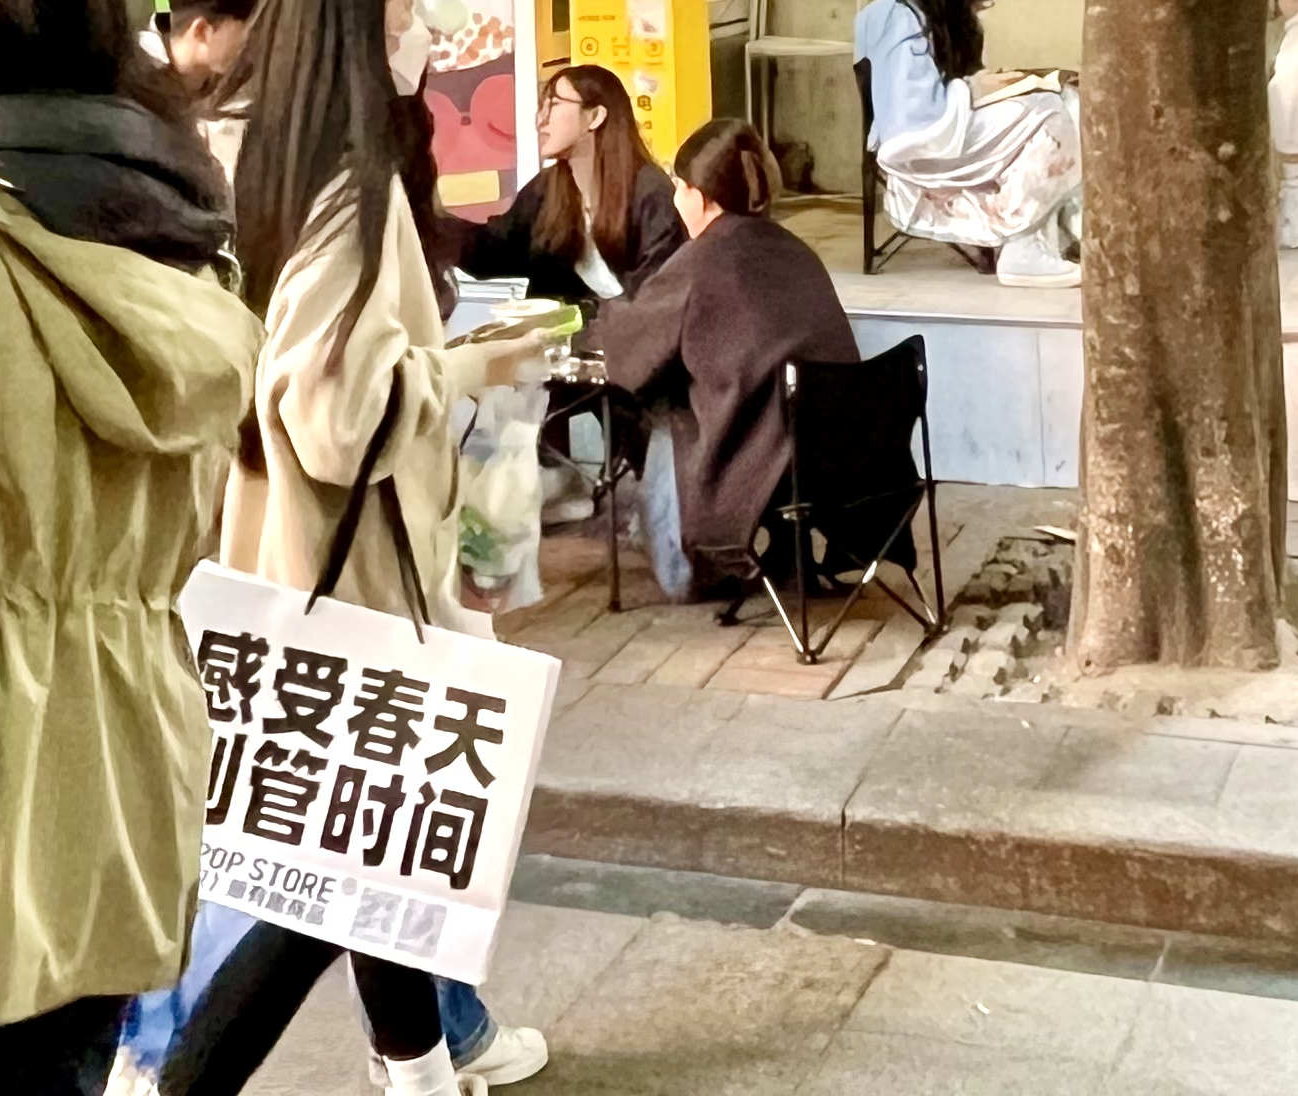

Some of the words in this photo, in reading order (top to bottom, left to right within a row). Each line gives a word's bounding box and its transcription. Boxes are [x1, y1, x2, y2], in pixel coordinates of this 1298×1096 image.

[197, 629, 507, 789] 感受春天
[248, 857, 337, 904] STORE
